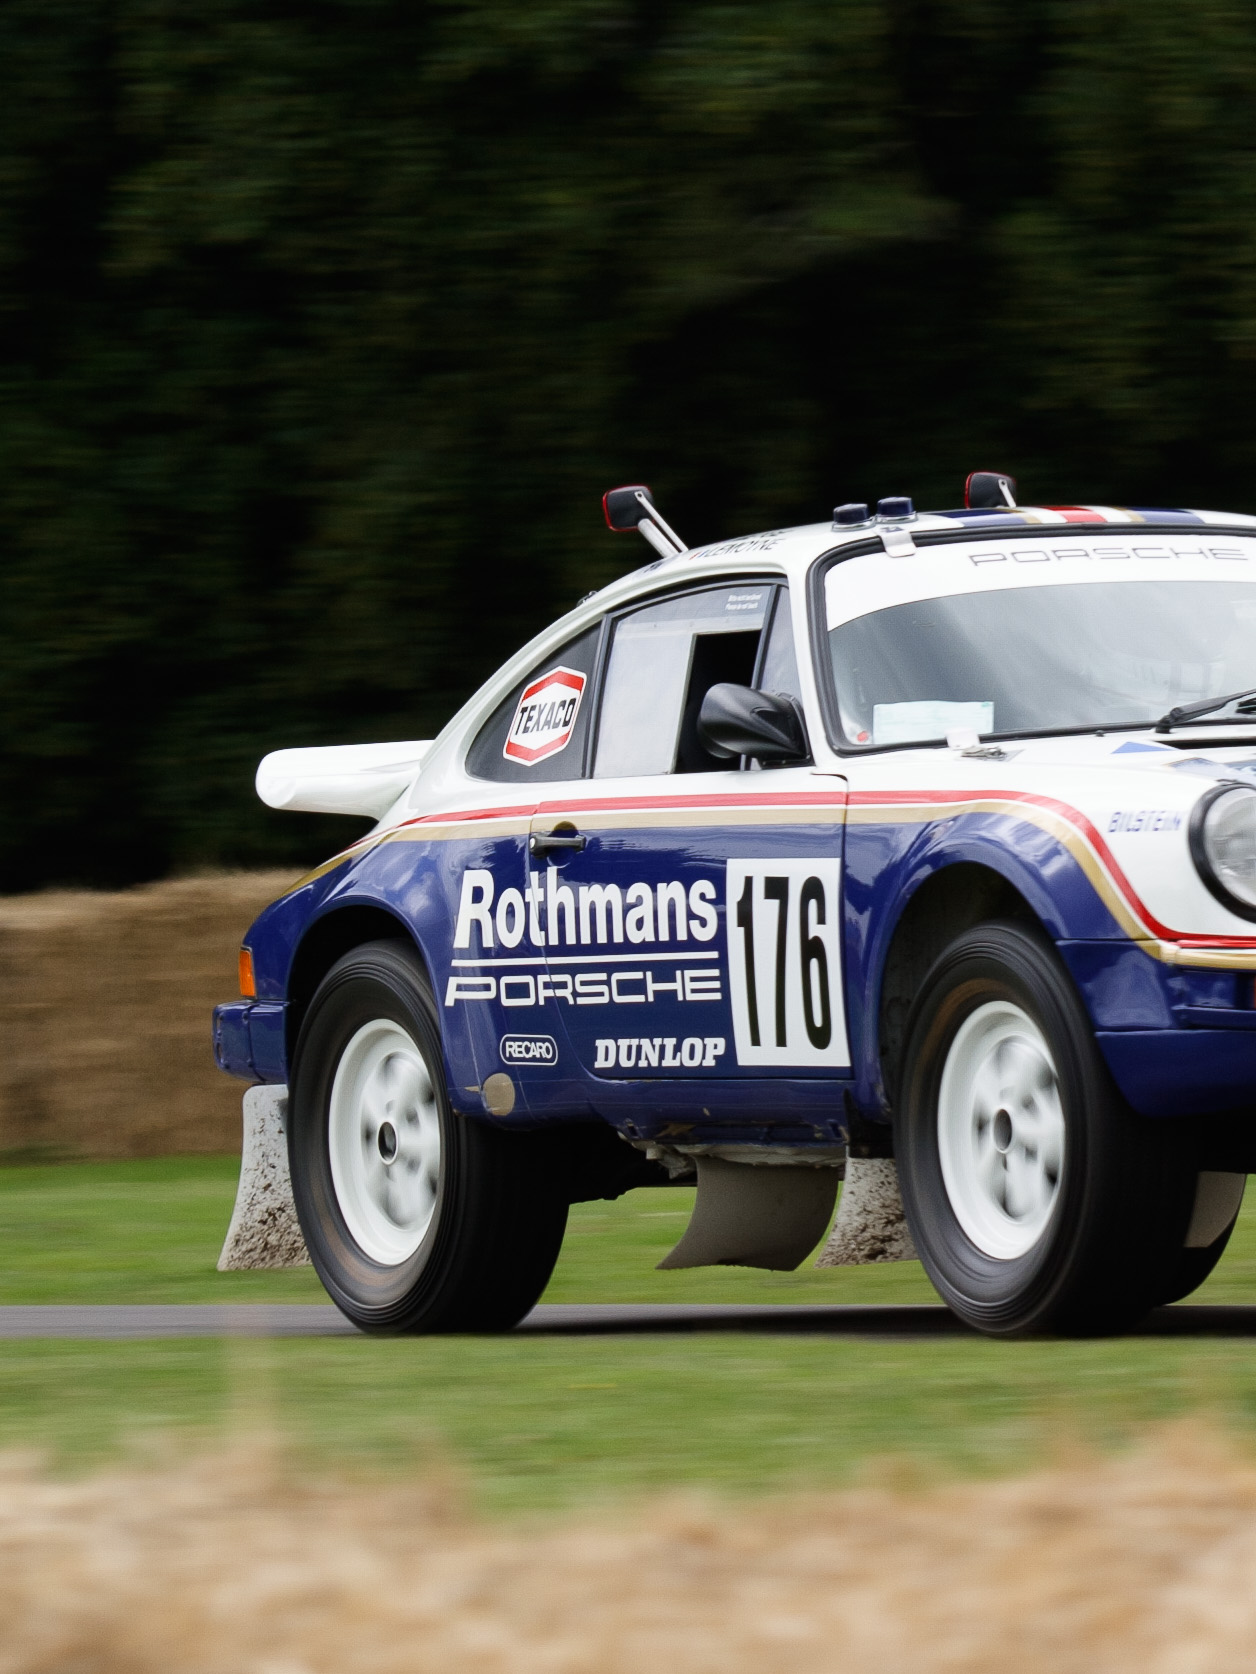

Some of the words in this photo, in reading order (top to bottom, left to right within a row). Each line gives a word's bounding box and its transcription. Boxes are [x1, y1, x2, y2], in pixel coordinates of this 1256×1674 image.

[968, 547, 1248, 567] PORSCHE
[515, 697, 577, 735] TEXACO
[1108, 811, 1181, 832] BILSTEIN
[453, 866, 718, 949] Rothmans
[737, 875, 832, 1050] 176
[445, 969, 722, 1006] PORSCHE
[505, 1041, 553, 1058] RECARO
[594, 1037, 725, 1069] DUNLOP
